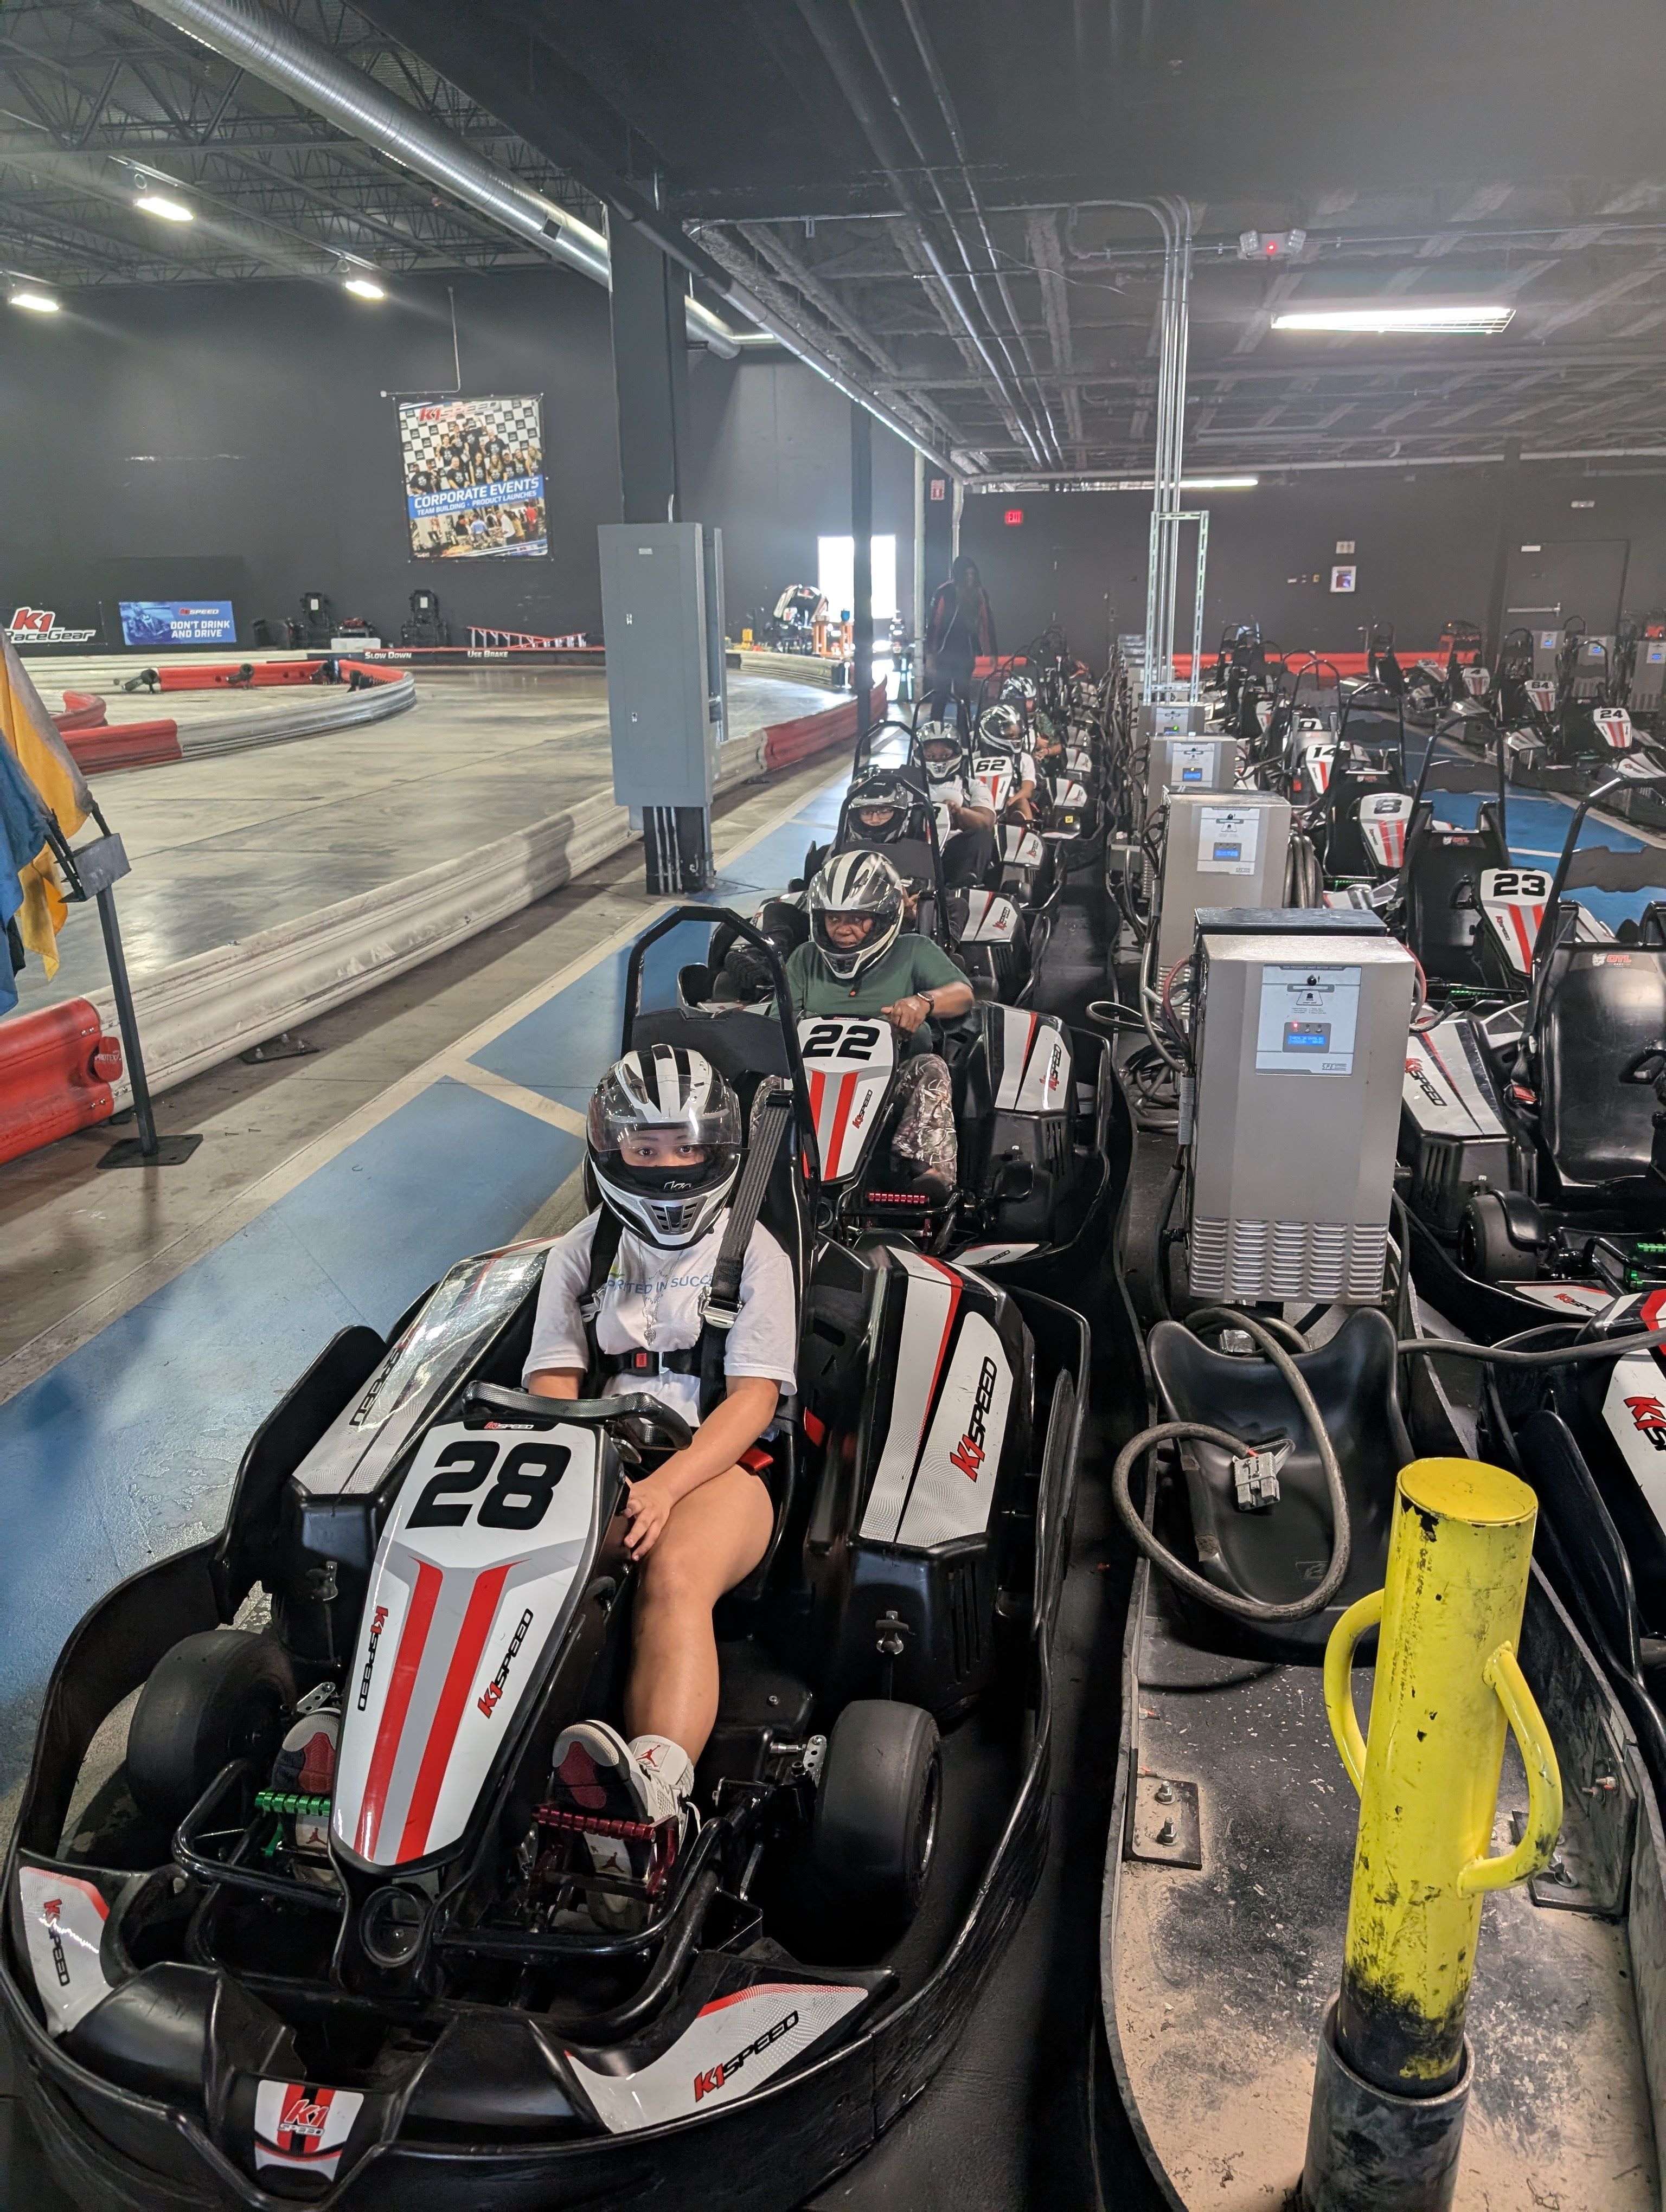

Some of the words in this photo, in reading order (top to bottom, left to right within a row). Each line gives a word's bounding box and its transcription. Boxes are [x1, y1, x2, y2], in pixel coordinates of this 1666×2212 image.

[414, 485, 487, 509] CORPORATE
[490, 477, 539, 496] EVENTS
[417, 507, 435, 516] TEAM
[436, 503, 465, 513] BUILDING
[472, 497, 502, 507] PRODUCT
[503, 490, 536, 502] LAUNCHES
[12, 608, 54, 632] K1
[170, 621, 198, 629] DON'T
[201, 620, 230, 629] DRINK
[171, 629, 193, 638] AND
[195, 628, 223, 638] DRIVE
[1600, 710, 1623, 719] 24
[976, 760, 1006, 773] 62
[1374, 799, 1402, 814] 8
[1494, 873, 1546, 897] 23
[802, 1024, 881, 1061] 22
[606, 1279, 652, 1294] PIRITED
[656, 1282, 667, 1293] IN
[405, 1441, 572, 1531] 28
